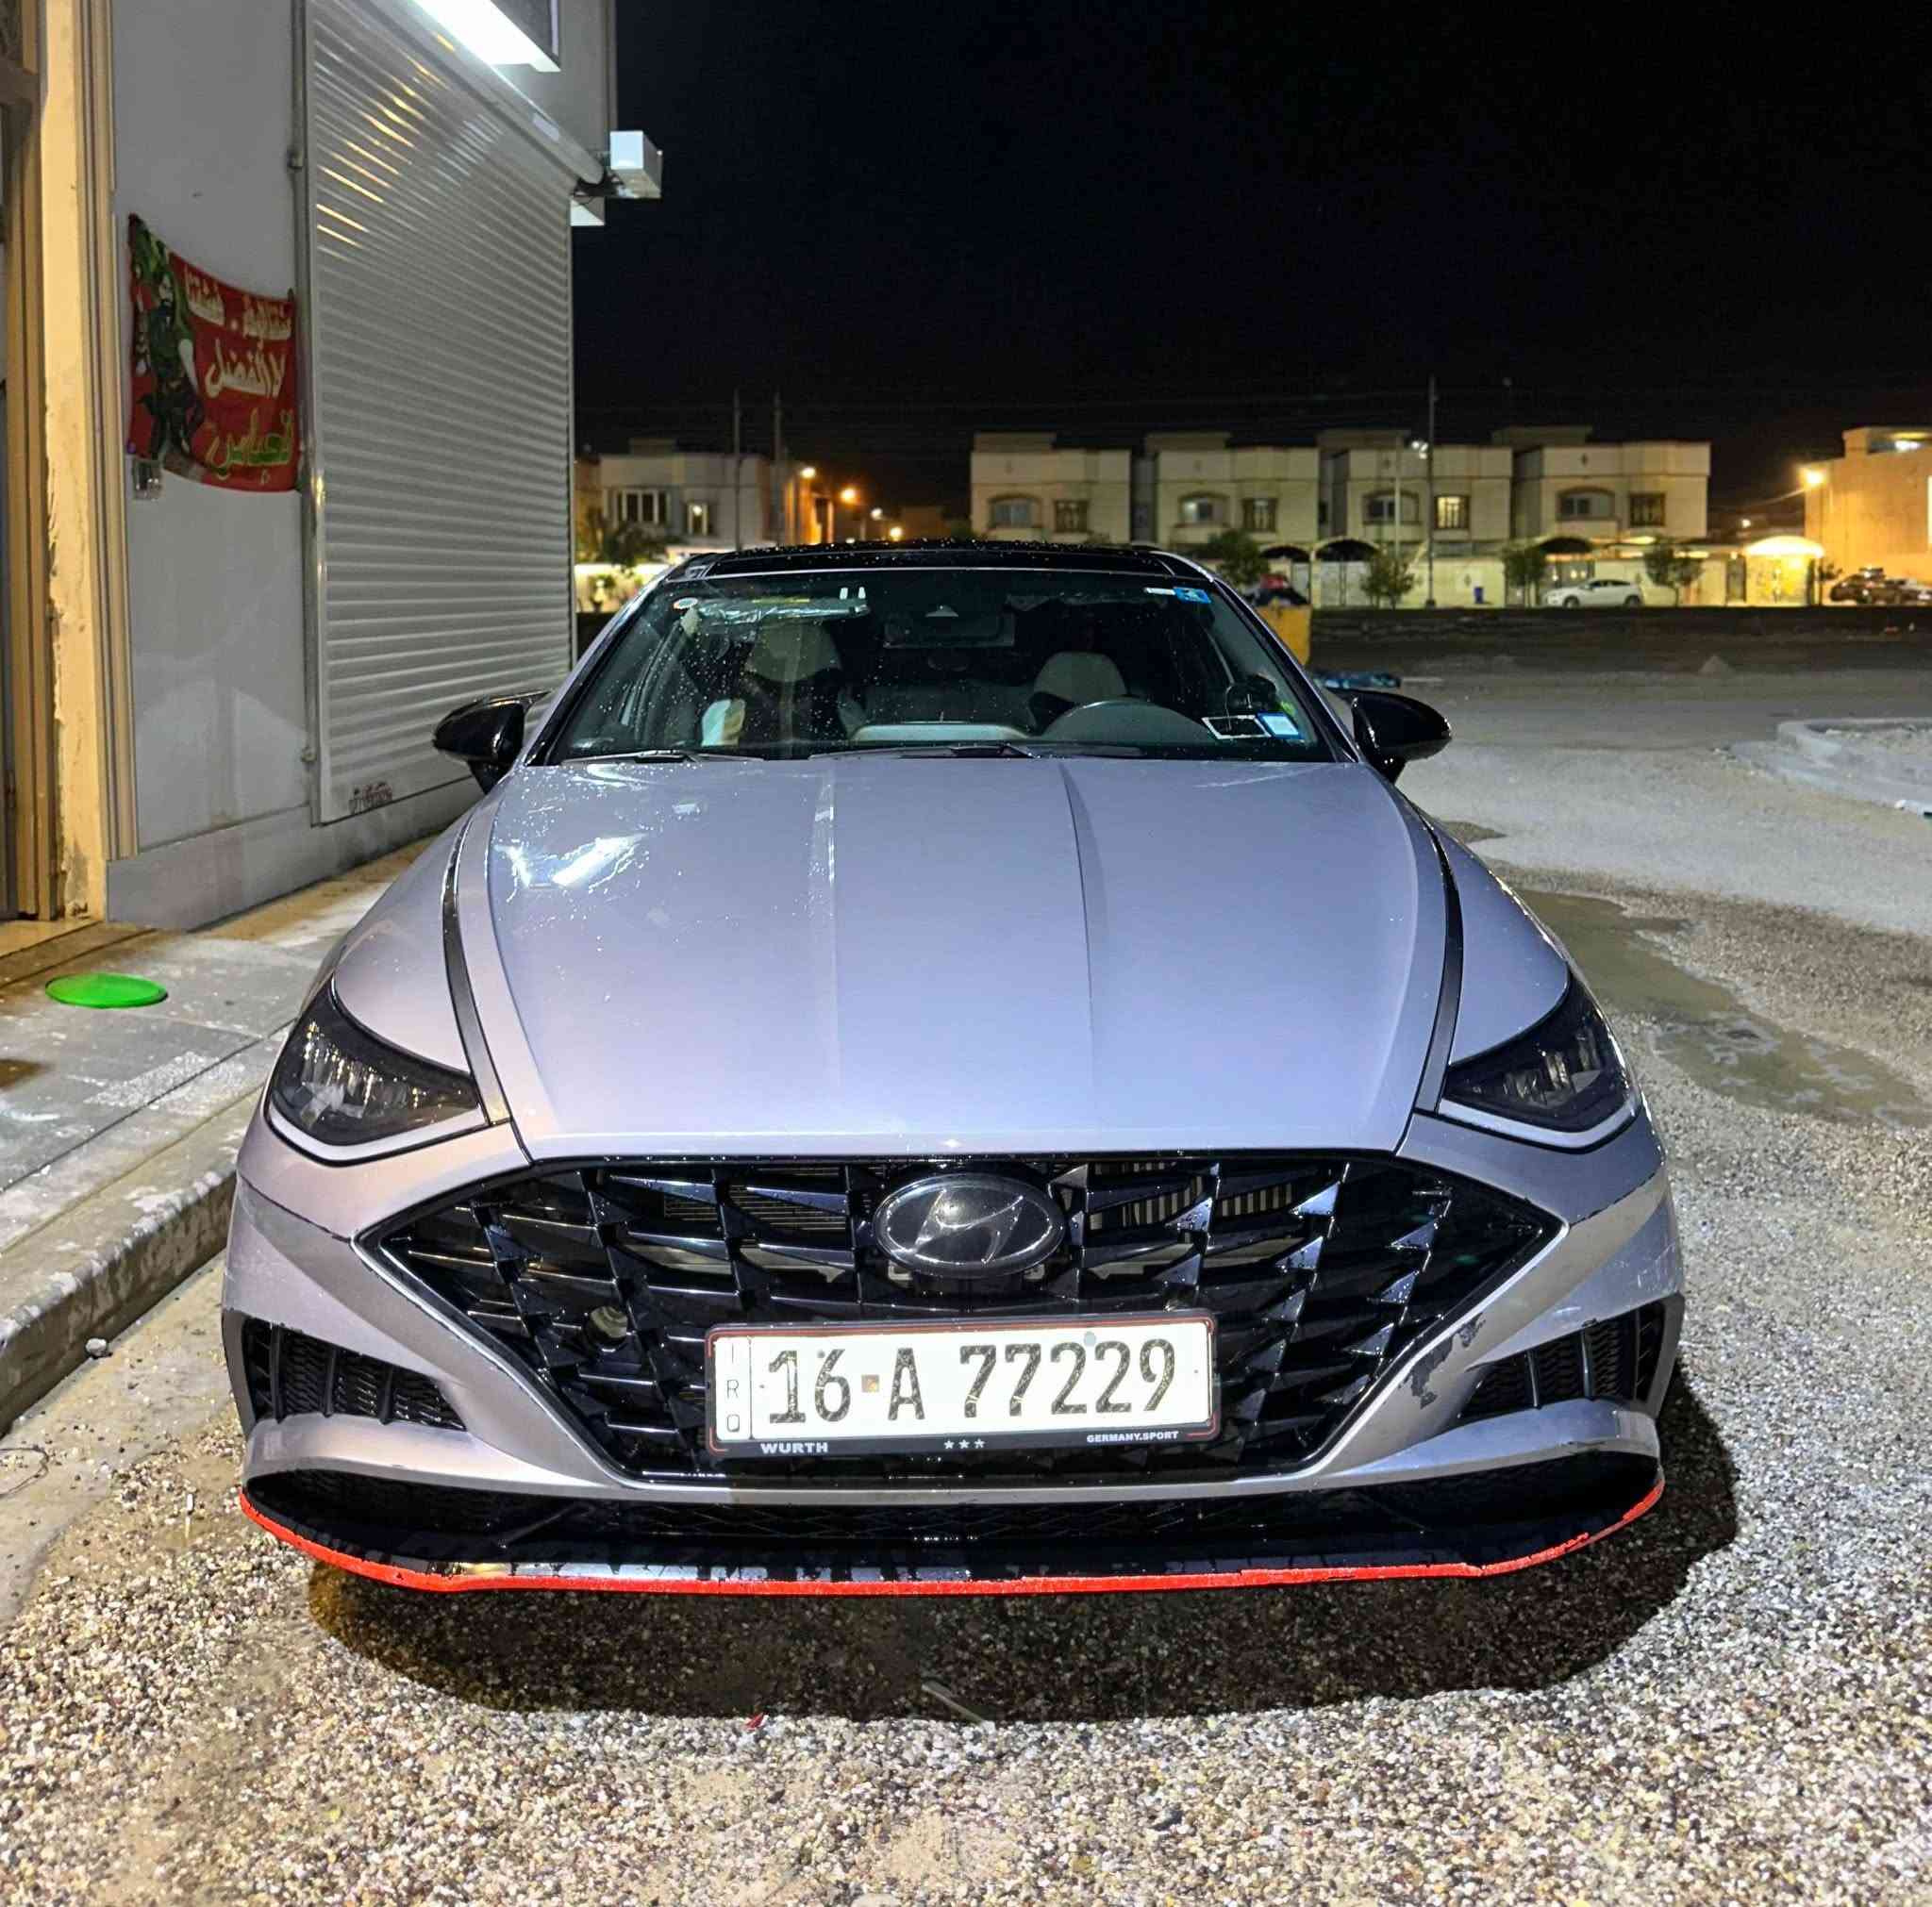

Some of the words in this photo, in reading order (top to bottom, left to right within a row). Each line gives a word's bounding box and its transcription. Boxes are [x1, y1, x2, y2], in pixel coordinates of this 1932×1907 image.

[768, 1348, 852, 1424] 16
[888, 1347, 925, 1421] A
[959, 1338, 1175, 1418] 77229
[760, 1441, 829, 1454] WURTH
